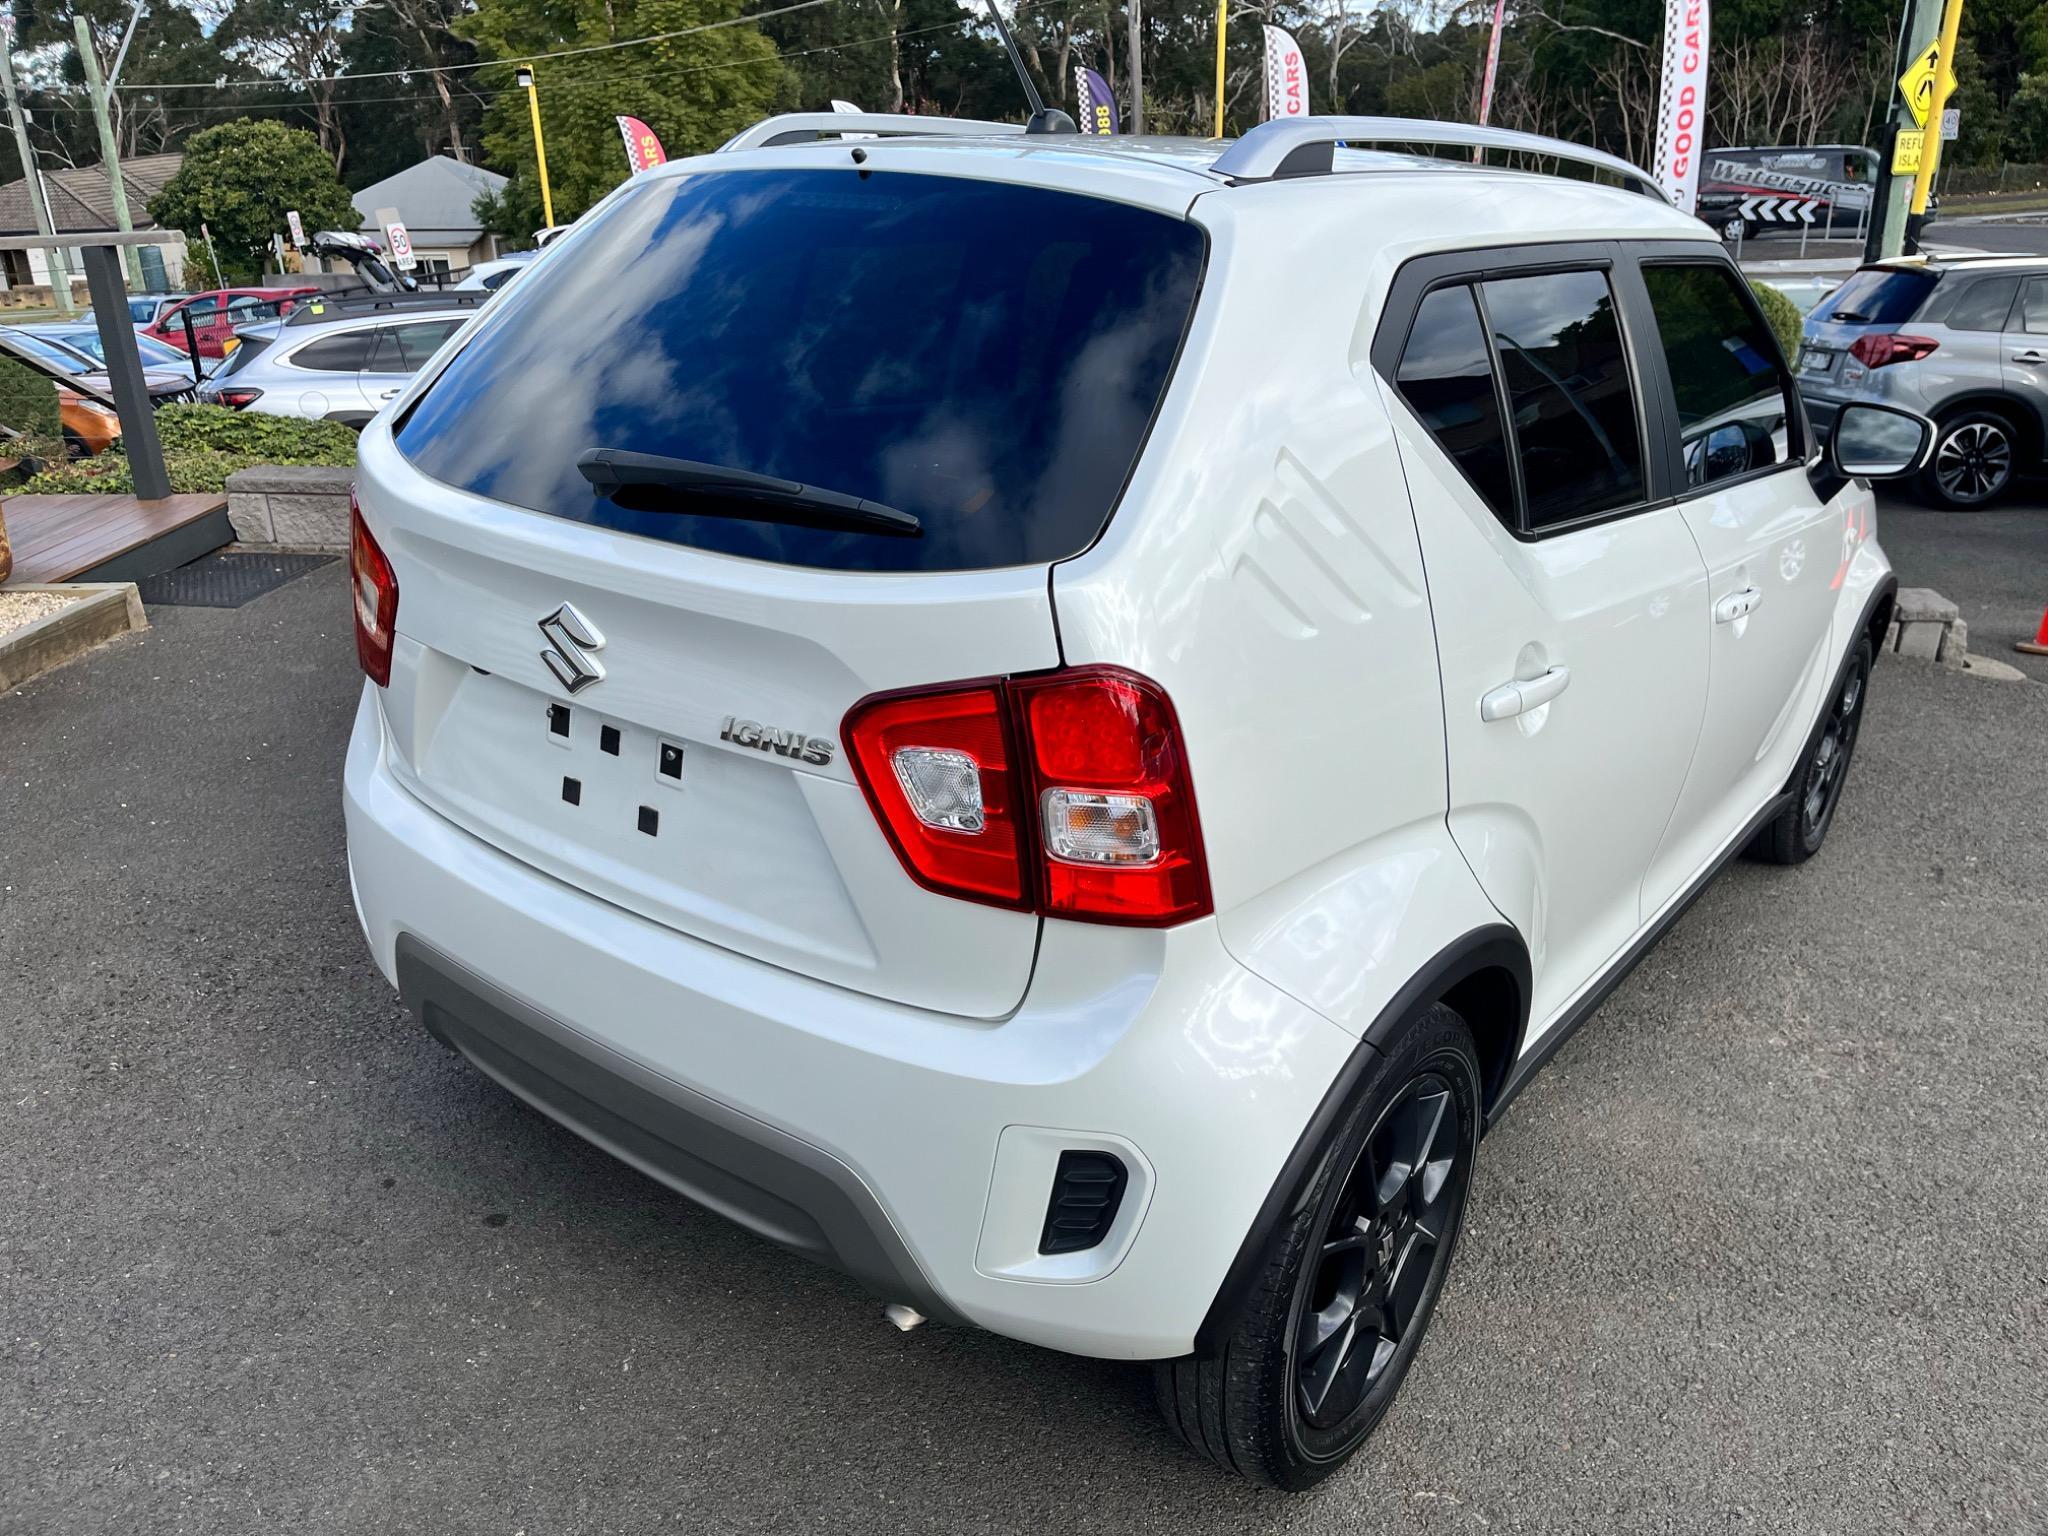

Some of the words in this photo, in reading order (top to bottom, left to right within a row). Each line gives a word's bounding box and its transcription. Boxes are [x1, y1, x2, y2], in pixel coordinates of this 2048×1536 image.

[1285, 52, 1300, 114] CARS
[1673, 85, 1696, 178] GOOD
[1710, 160, 1874, 197] Waterspo
[393, 234, 407, 249] 50
[720, 714, 835, 767] IGNIS
